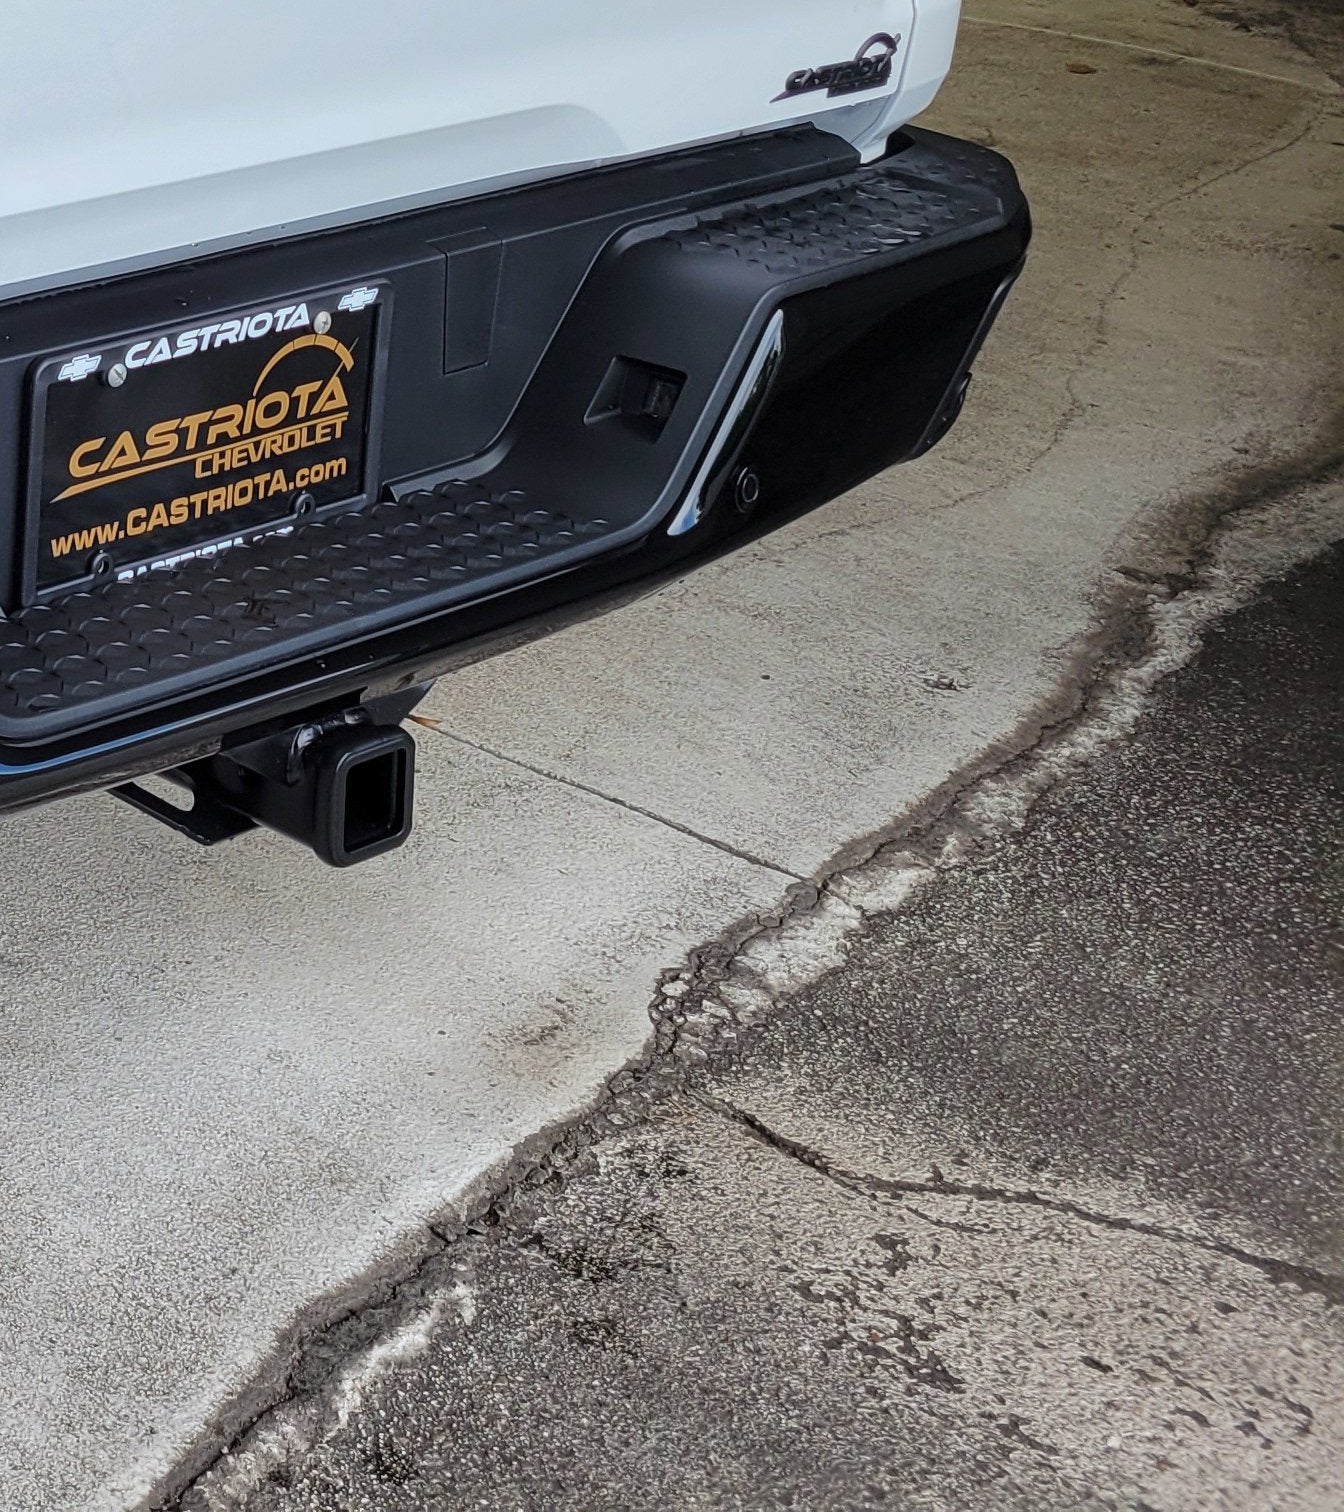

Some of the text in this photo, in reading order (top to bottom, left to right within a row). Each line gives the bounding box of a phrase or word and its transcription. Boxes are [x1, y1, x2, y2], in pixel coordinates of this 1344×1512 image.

[124, 302, 311, 370] CASTRIOTA
[68, 376, 349, 479] CASTRIOTA
[194, 415, 349, 480] CHEVROLET
[50, 456, 347, 558] www.CASTRIOTA.com
